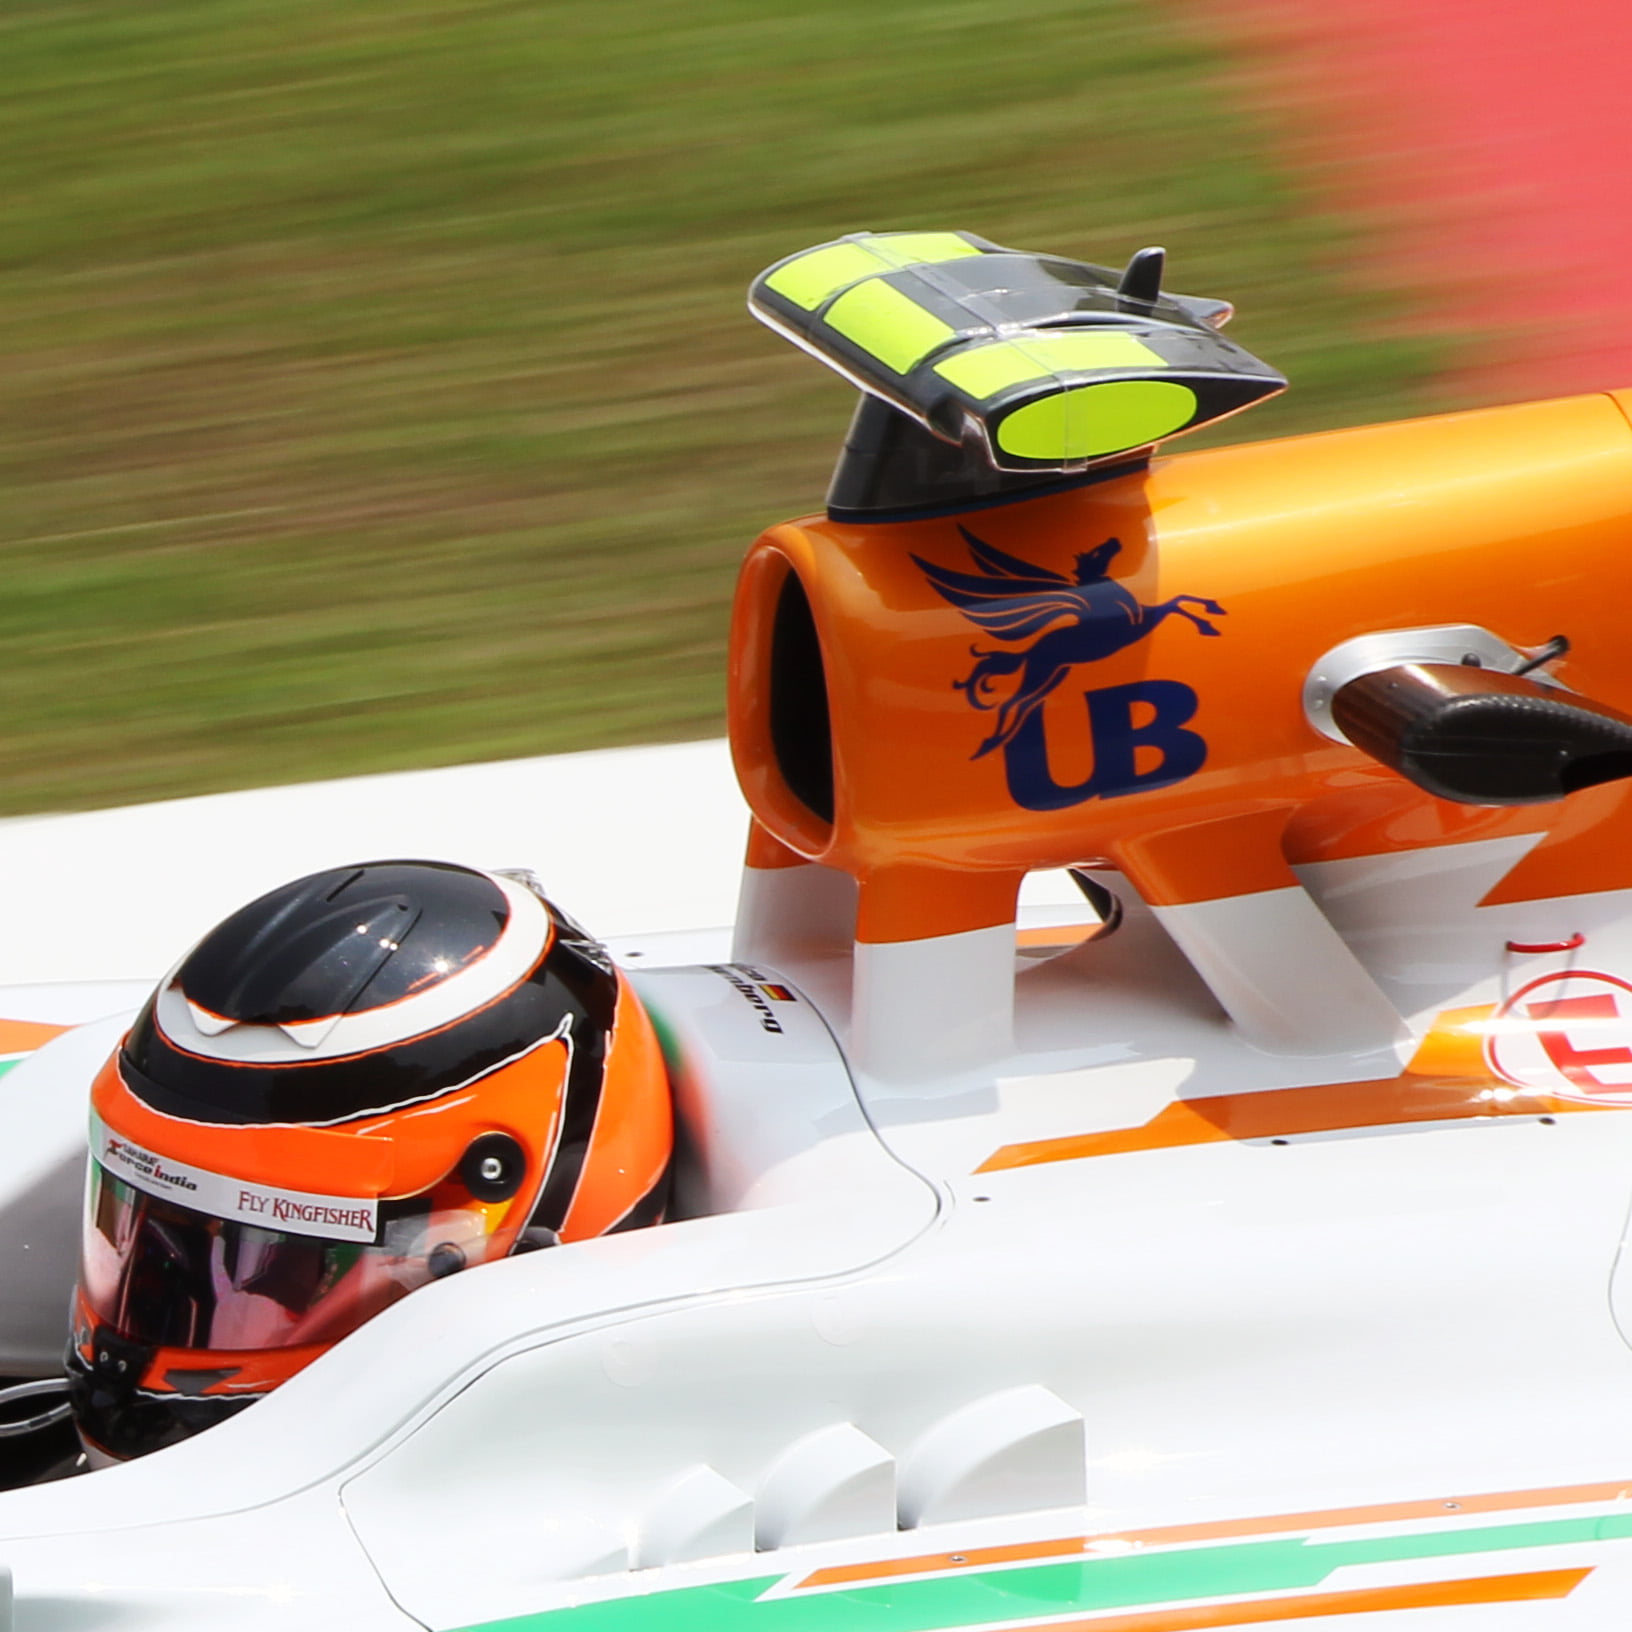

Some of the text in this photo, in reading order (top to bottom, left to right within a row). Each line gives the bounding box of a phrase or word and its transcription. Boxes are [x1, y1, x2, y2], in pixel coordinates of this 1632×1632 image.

[1002, 679, 1207, 811] UB
[238, 1190, 375, 1233] FLY KINGFISHER
